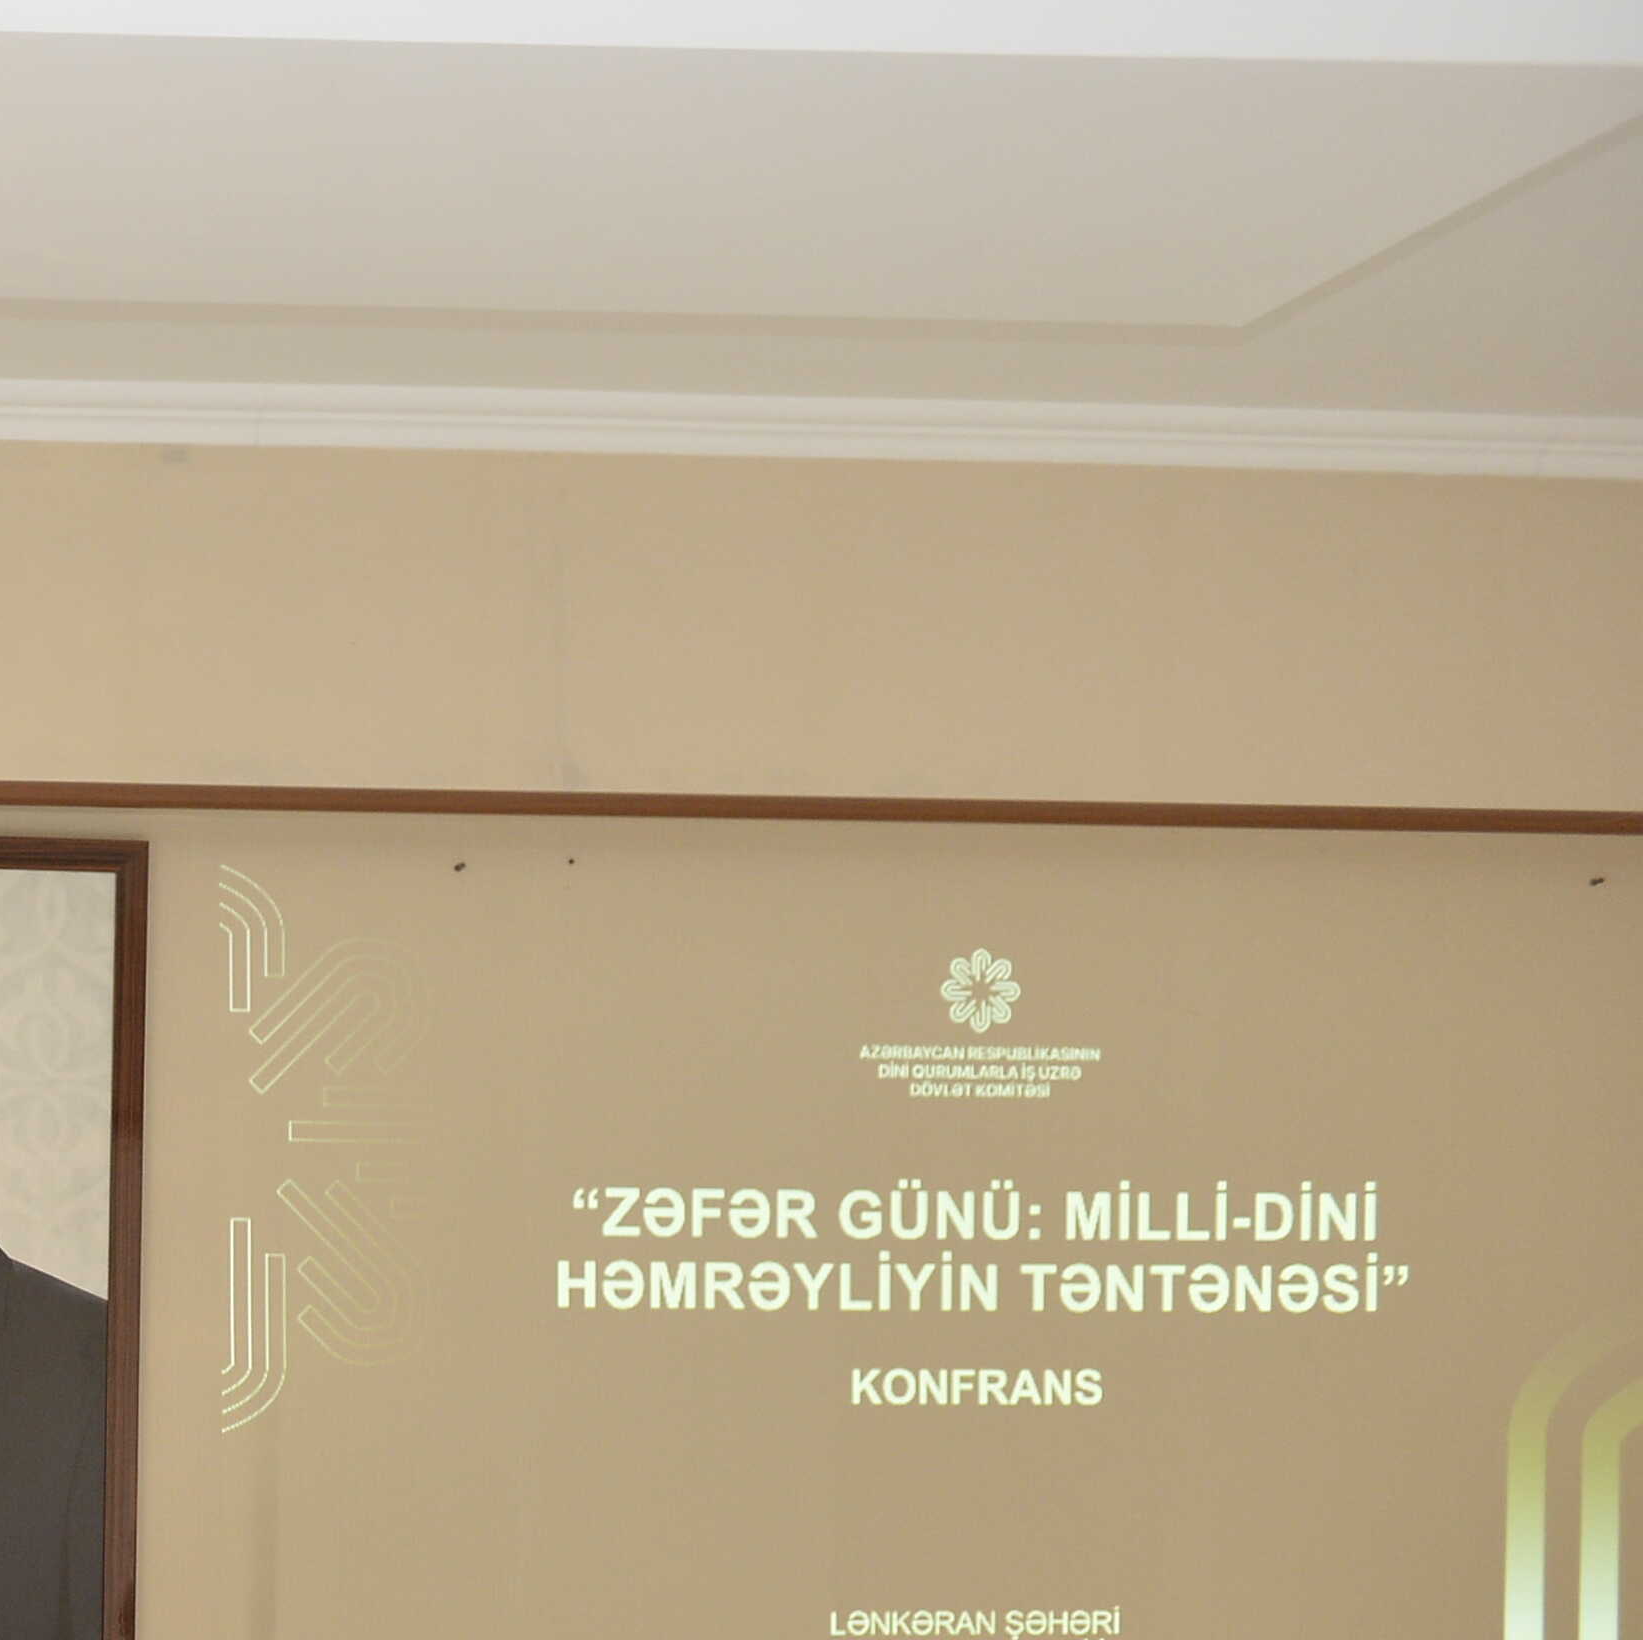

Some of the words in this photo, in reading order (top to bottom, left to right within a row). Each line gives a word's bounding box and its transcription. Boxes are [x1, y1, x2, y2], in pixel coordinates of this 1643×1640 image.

[859, 1044, 965, 1061] AZƏRBAYCAN
[878, 1061, 910, 1079] DİNİ
[912, 1063, 1018, 1080] QURUMLARLA
[1020, 1061, 1036, 1082] İŞ
[909, 1081, 972, 1098] DÖVLƏT
[974, 1081, 1052, 1099] KOMİTƏSİ
[572, 1187, 818, 1239] “ZƏFƏR
[838, 1179, 1042, 1241] GÜNÜ:
[1065, 1180, 1378, 1241] MİLLİ-DİNİ
[557, 1250, 998, 1312] HƏMRƏYLİYİN
[1020, 1252, 1409, 1313] TƏNTƏNƏSİ”
[851, 1367, 1104, 1406] KONFRANS
[830, 1609, 996, 1636] LƏNKƏRAN
[1005, 1605, 1121, 1640] ŞƏHƏRİ
